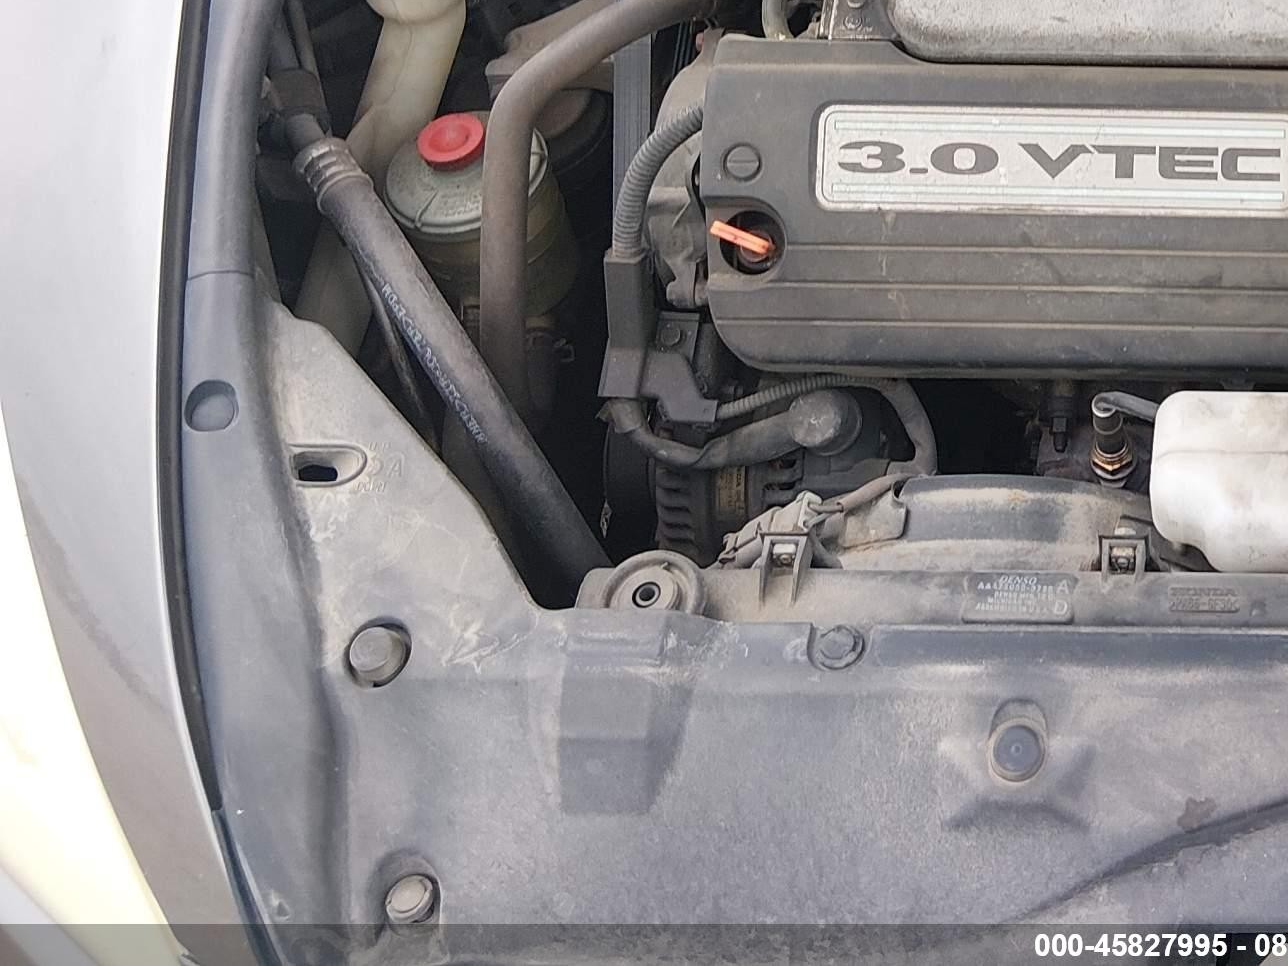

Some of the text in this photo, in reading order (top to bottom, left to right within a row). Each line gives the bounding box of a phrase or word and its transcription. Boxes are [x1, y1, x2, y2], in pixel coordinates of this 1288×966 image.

[837, 141, 1281, 181] 3.0 VTEC
[999, 575, 1038, 585] DENSO
